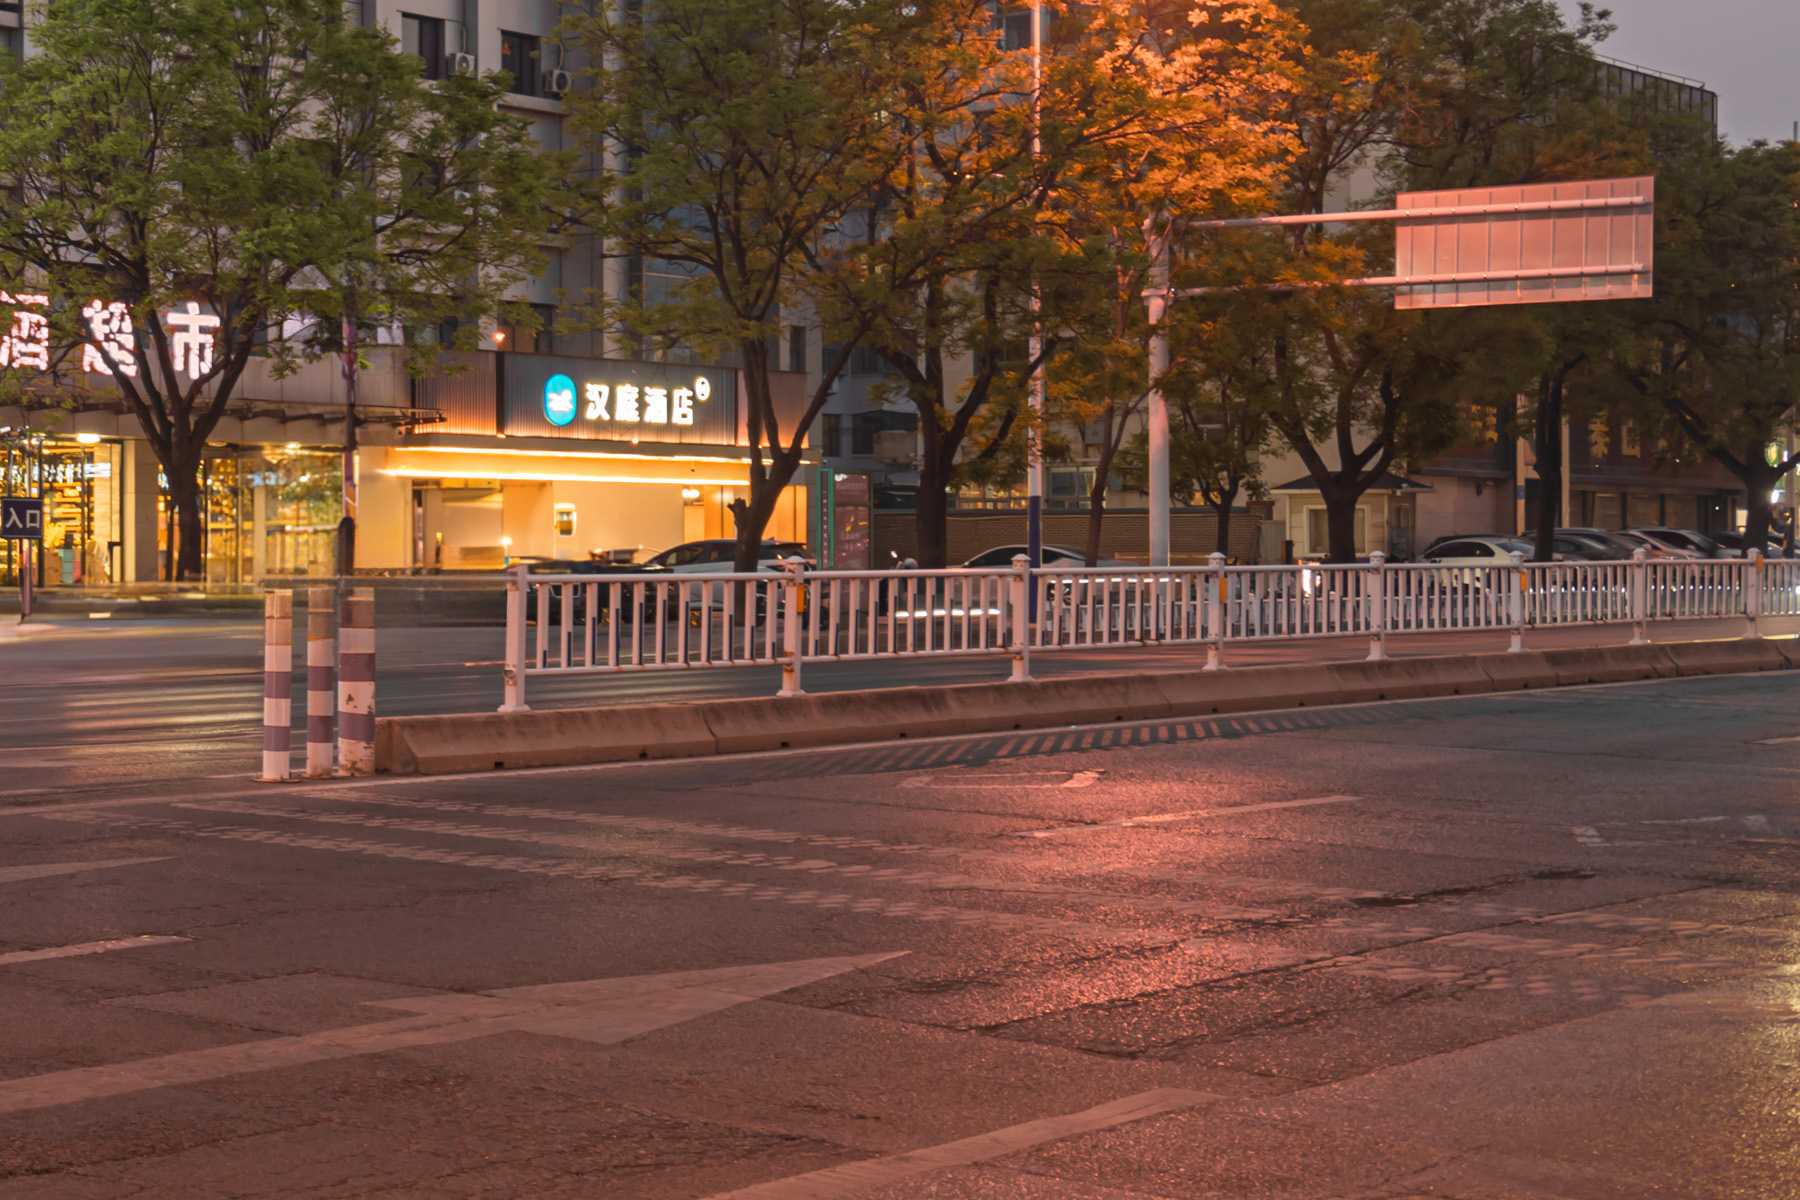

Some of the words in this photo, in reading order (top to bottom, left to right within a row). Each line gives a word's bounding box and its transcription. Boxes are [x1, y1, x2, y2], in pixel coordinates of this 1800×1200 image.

[584, 383, 694, 425] 汉庭酒店
[5, 507, 40, 528] 入口
